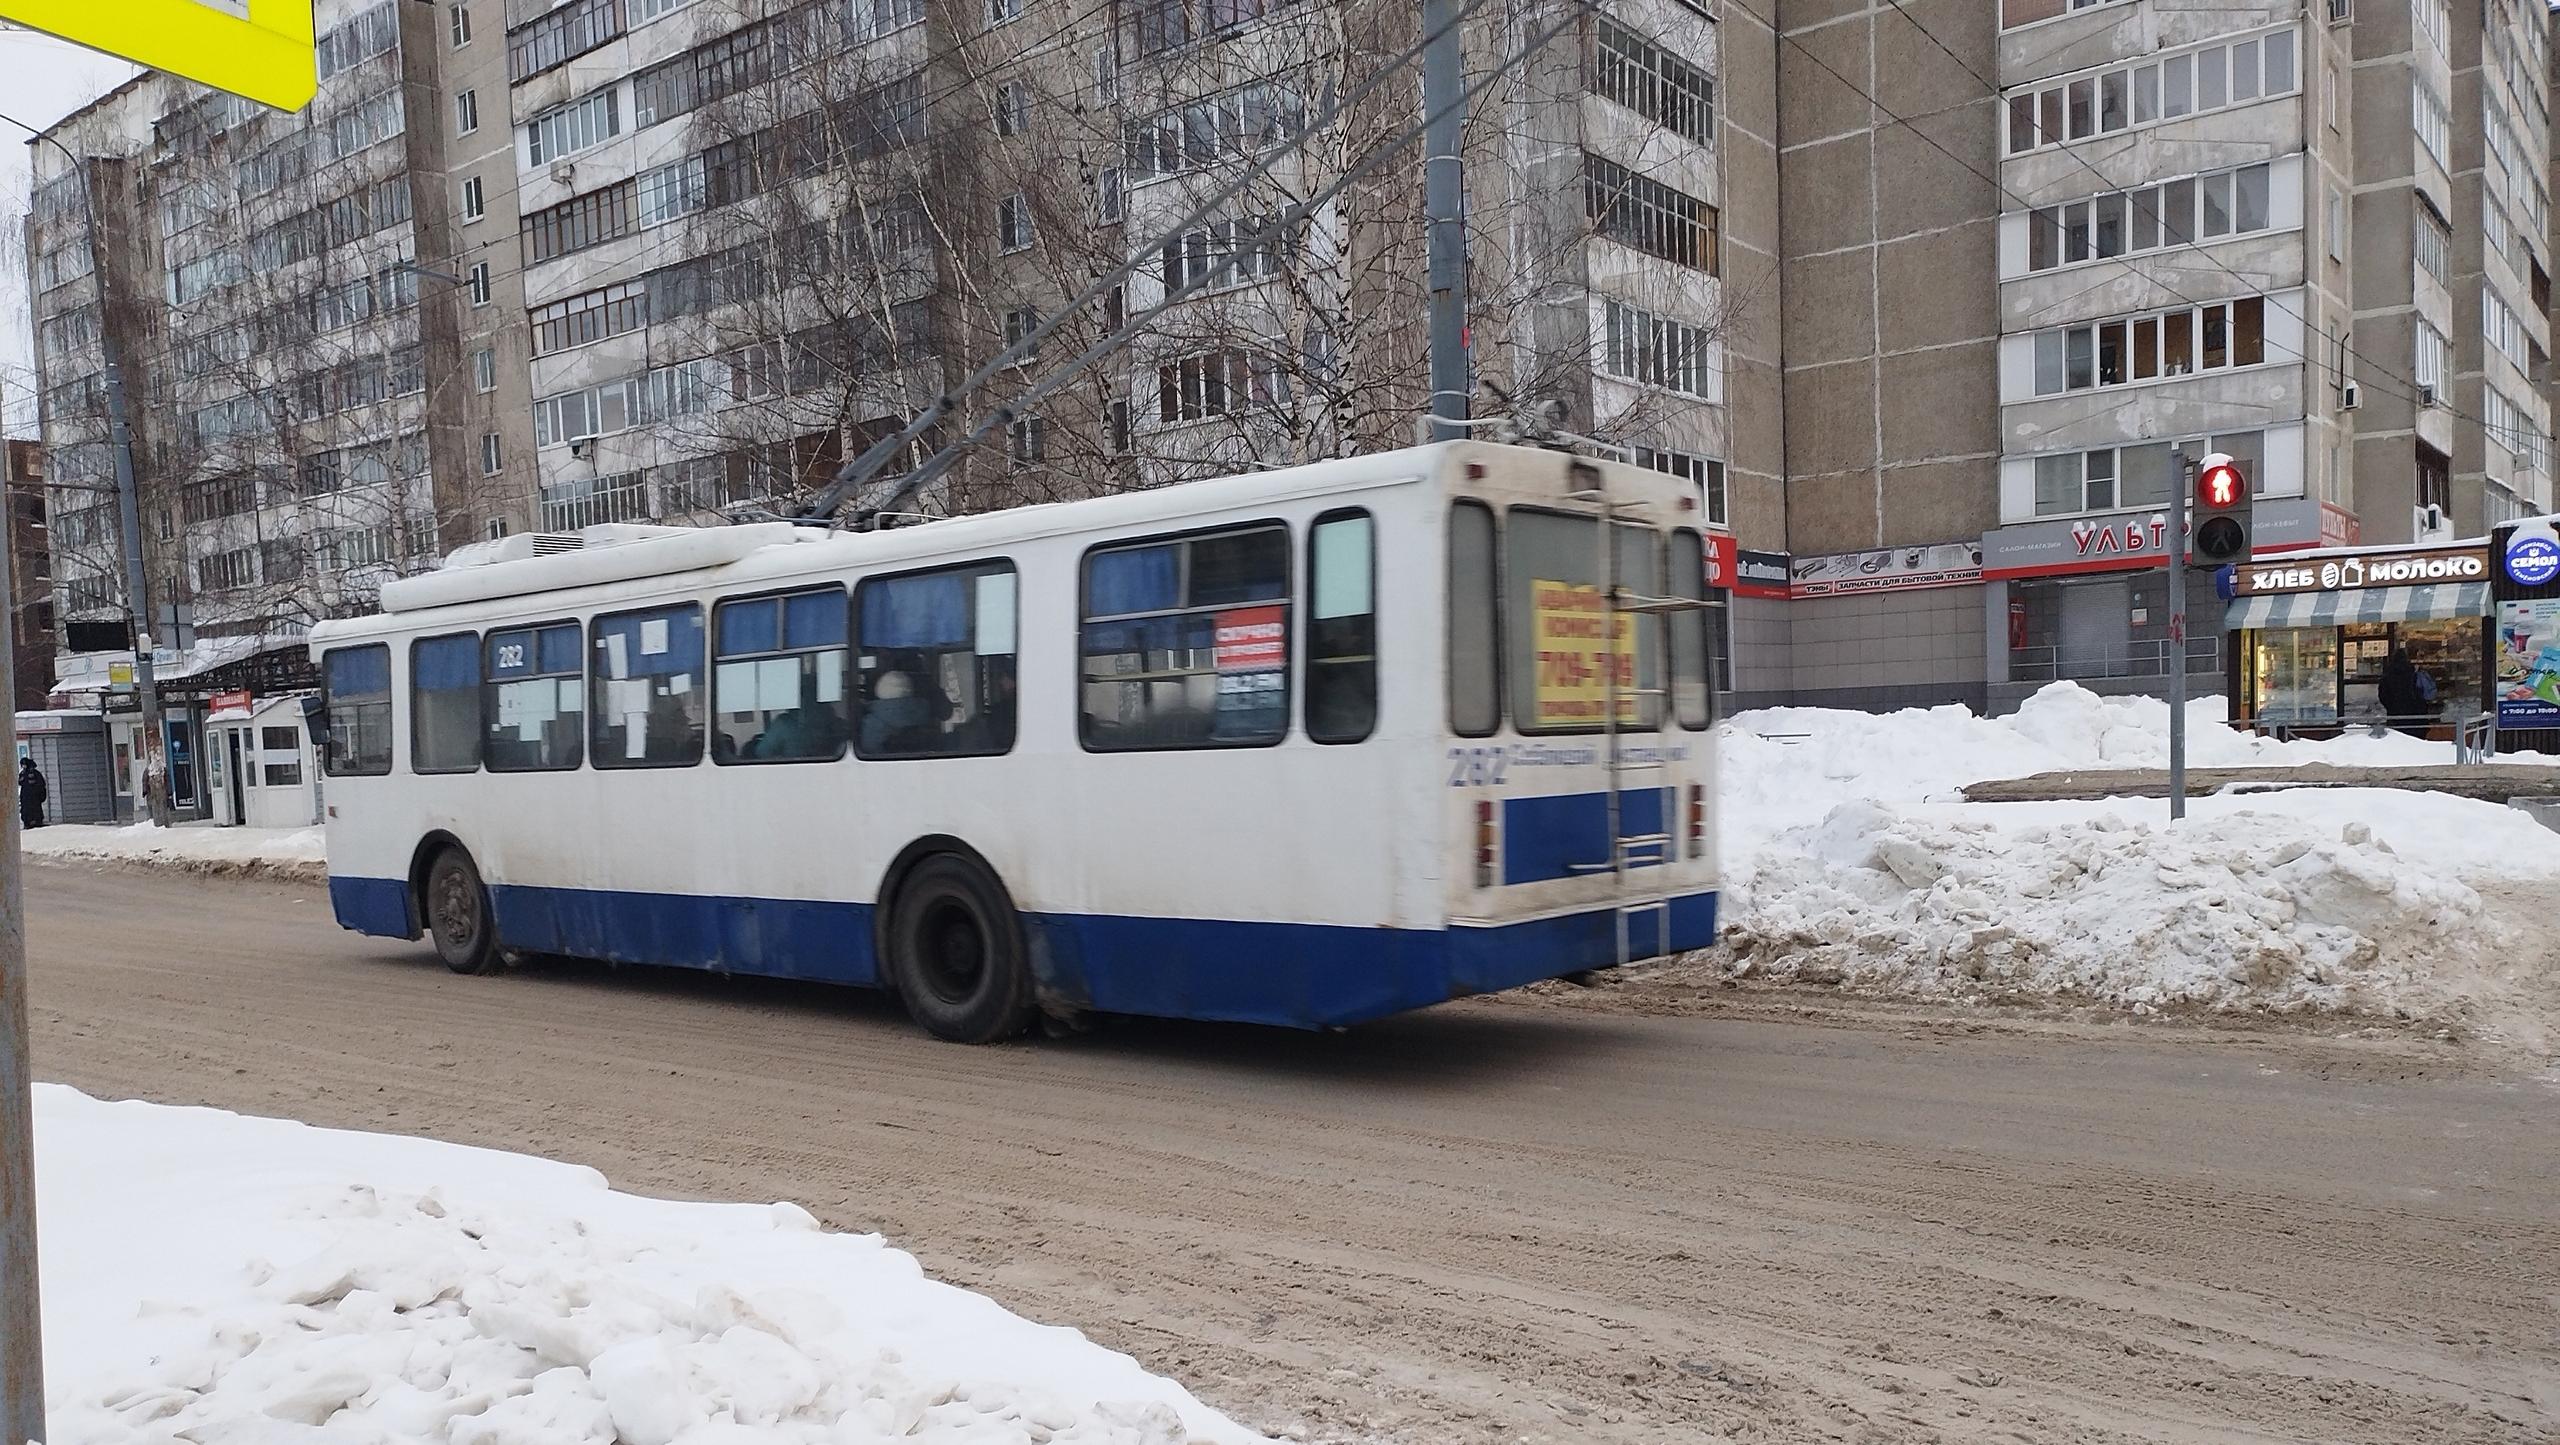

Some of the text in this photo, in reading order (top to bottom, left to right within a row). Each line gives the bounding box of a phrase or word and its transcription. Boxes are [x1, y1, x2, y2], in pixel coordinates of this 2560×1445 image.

[2072, 515, 2191, 555] УЛЬТ
[1999, 542, 2062, 553] САЛОН-МАГАЗИН
[2252, 557, 2482, 590] ХЛЕБ МОЛОКО
[2511, 555, 2558, 568] СЕМОЛ
[1838, 578, 1880, 590] ЗАПЧАСТИ
[1881, 576, 1900, 587] ДЛЯ
[1901, 572, 1944, 584] БЫТОВОЙ
[1945, 570, 1981, 580] ТЕХНИК
[499, 644, 524, 668] 282
[1447, 746, 1510, 787] 282
